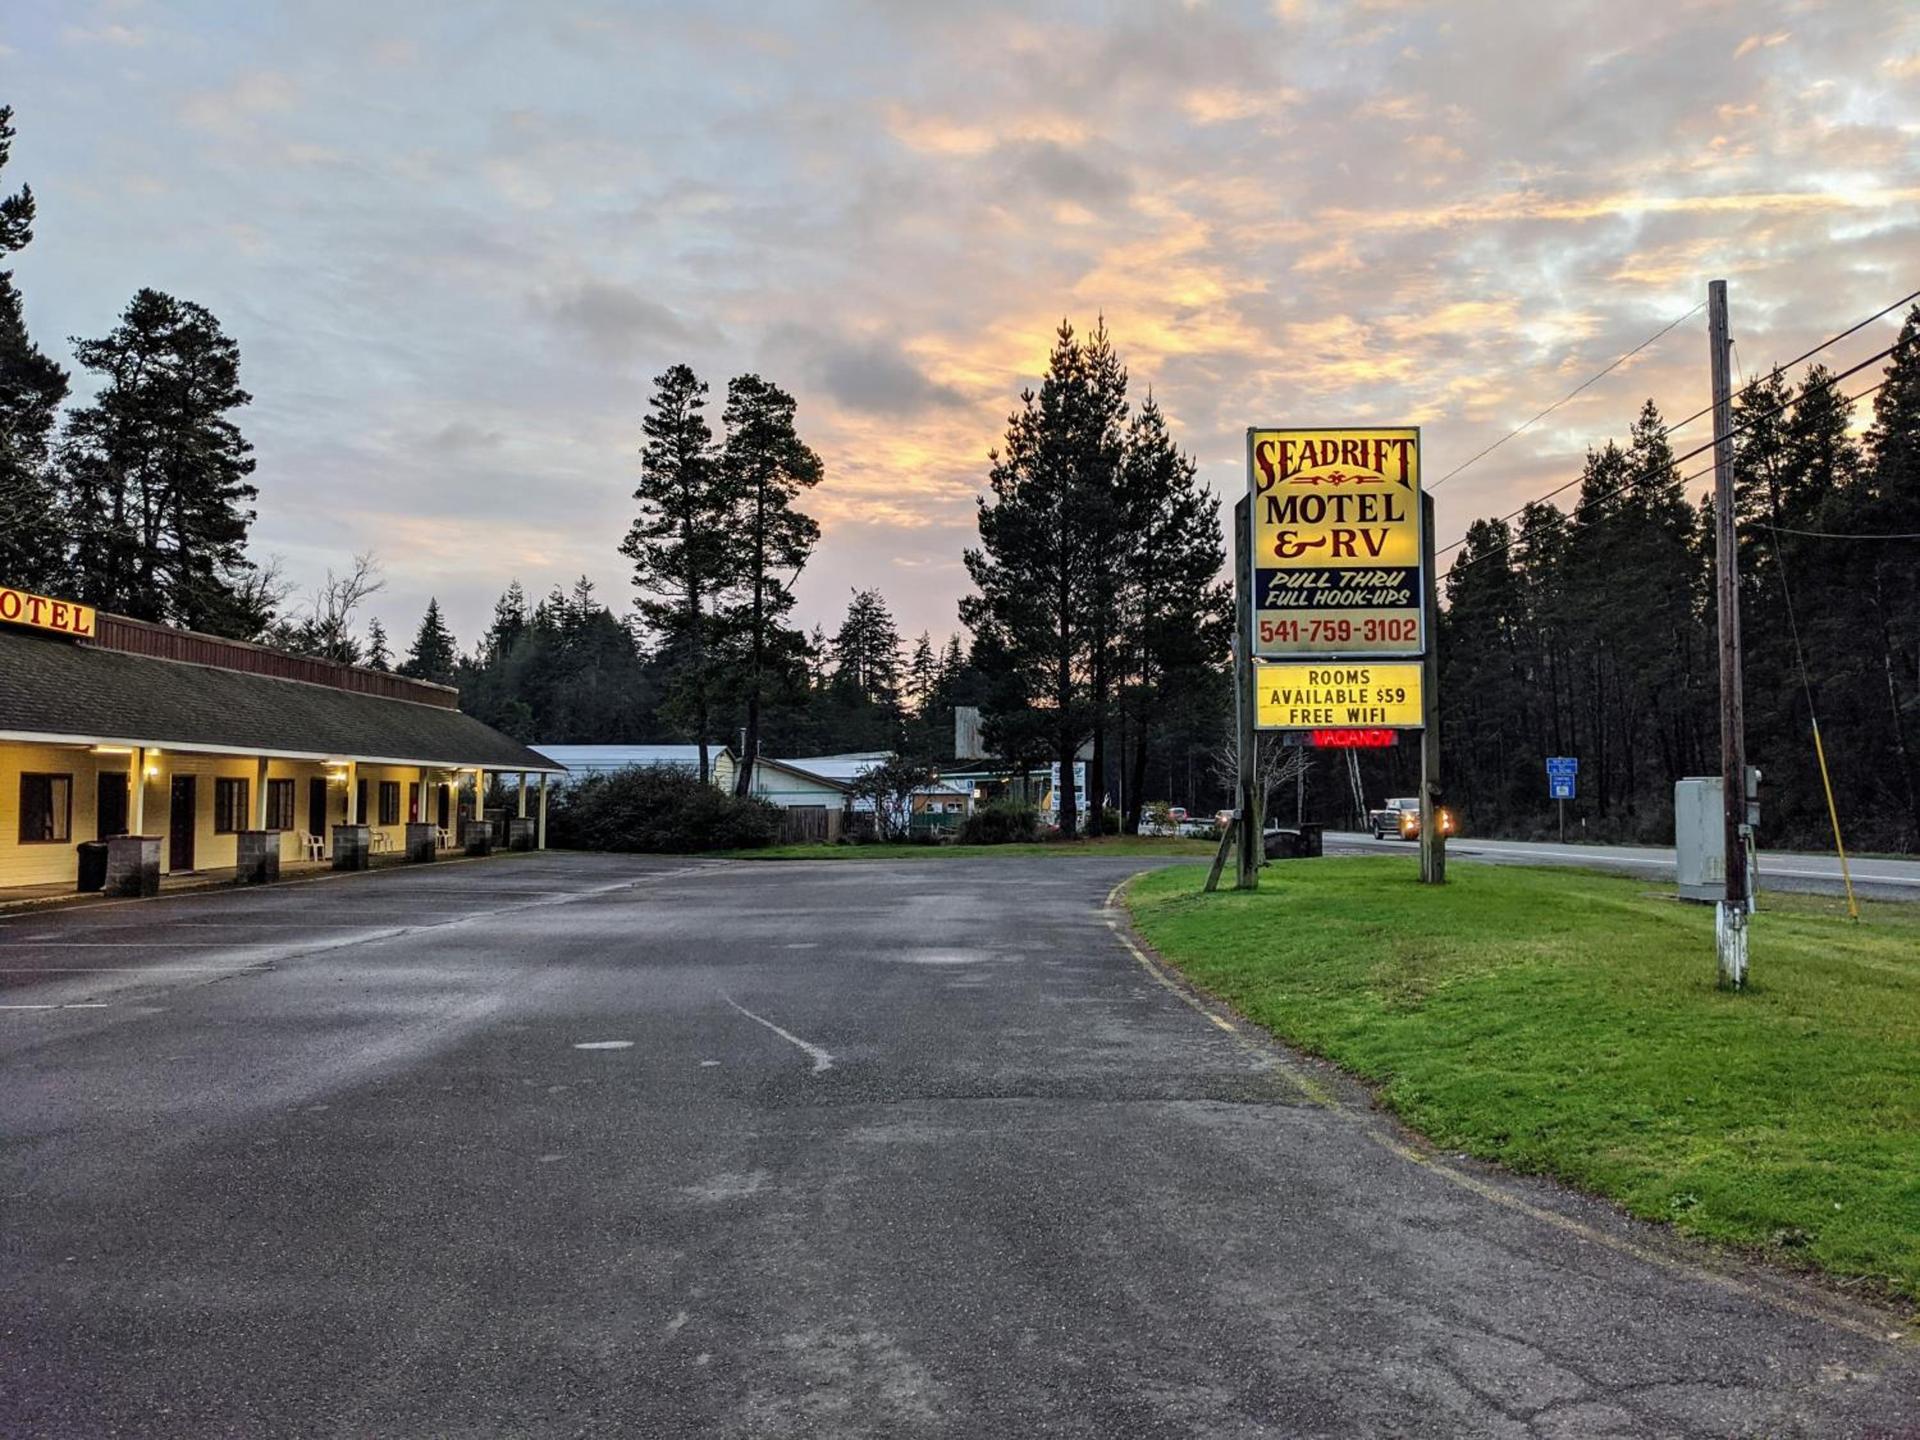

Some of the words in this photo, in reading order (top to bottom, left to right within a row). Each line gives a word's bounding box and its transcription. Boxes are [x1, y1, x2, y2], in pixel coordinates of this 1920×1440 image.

[1255, 439, 1415, 497] SEADRIFT
[1266, 494, 1405, 524] MOTEL
[1274, 531, 1327, 558] &
[1331, 528, 1389, 557] RV
[1268, 572, 1332, 588] PULL
[1339, 571, 1406, 587] THRU
[1265, 591, 1309, 606] FULL
[1313, 589, 1410, 605] HOOK-UPS
[1260, 619, 1416, 642] 541-759-3102
[1309, 670, 1370, 685] ROOMS
[1271, 689, 1368, 704] AVAILABLE
[1376, 688, 1406, 703] $59
[1290, 709, 1333, 723] FREE
[1347, 708, 1386, 722] WIFI
[1314, 730, 1393, 747] VACANCY
